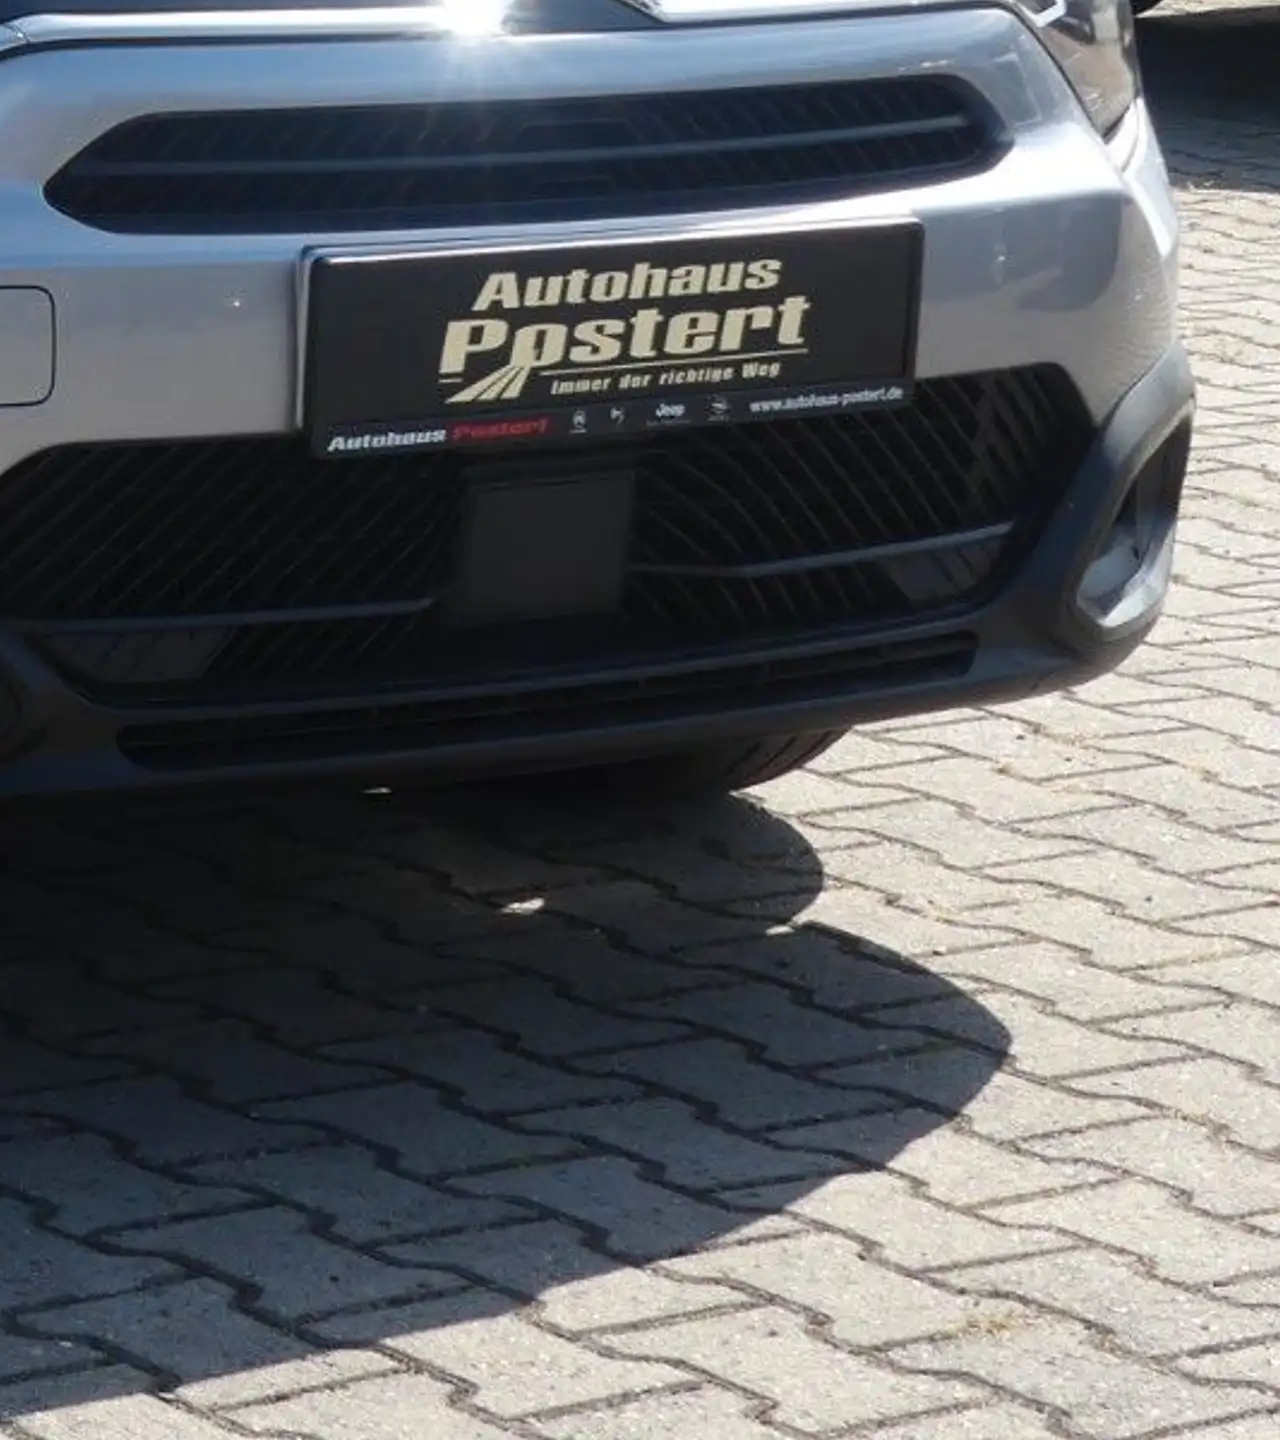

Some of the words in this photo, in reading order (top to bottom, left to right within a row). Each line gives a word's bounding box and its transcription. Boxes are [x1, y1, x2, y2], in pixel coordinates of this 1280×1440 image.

[471, 258, 783, 311] Autohaus
[439, 295, 811, 375] Postert
[550, 377, 611, 396] Immer
[618, 373, 651, 390] der
[659, 365, 734, 386] richtige
[742, 360, 781, 379] Weg
[327, 427, 447, 452] Autohaus
[452, 417, 549, 441] Postert
